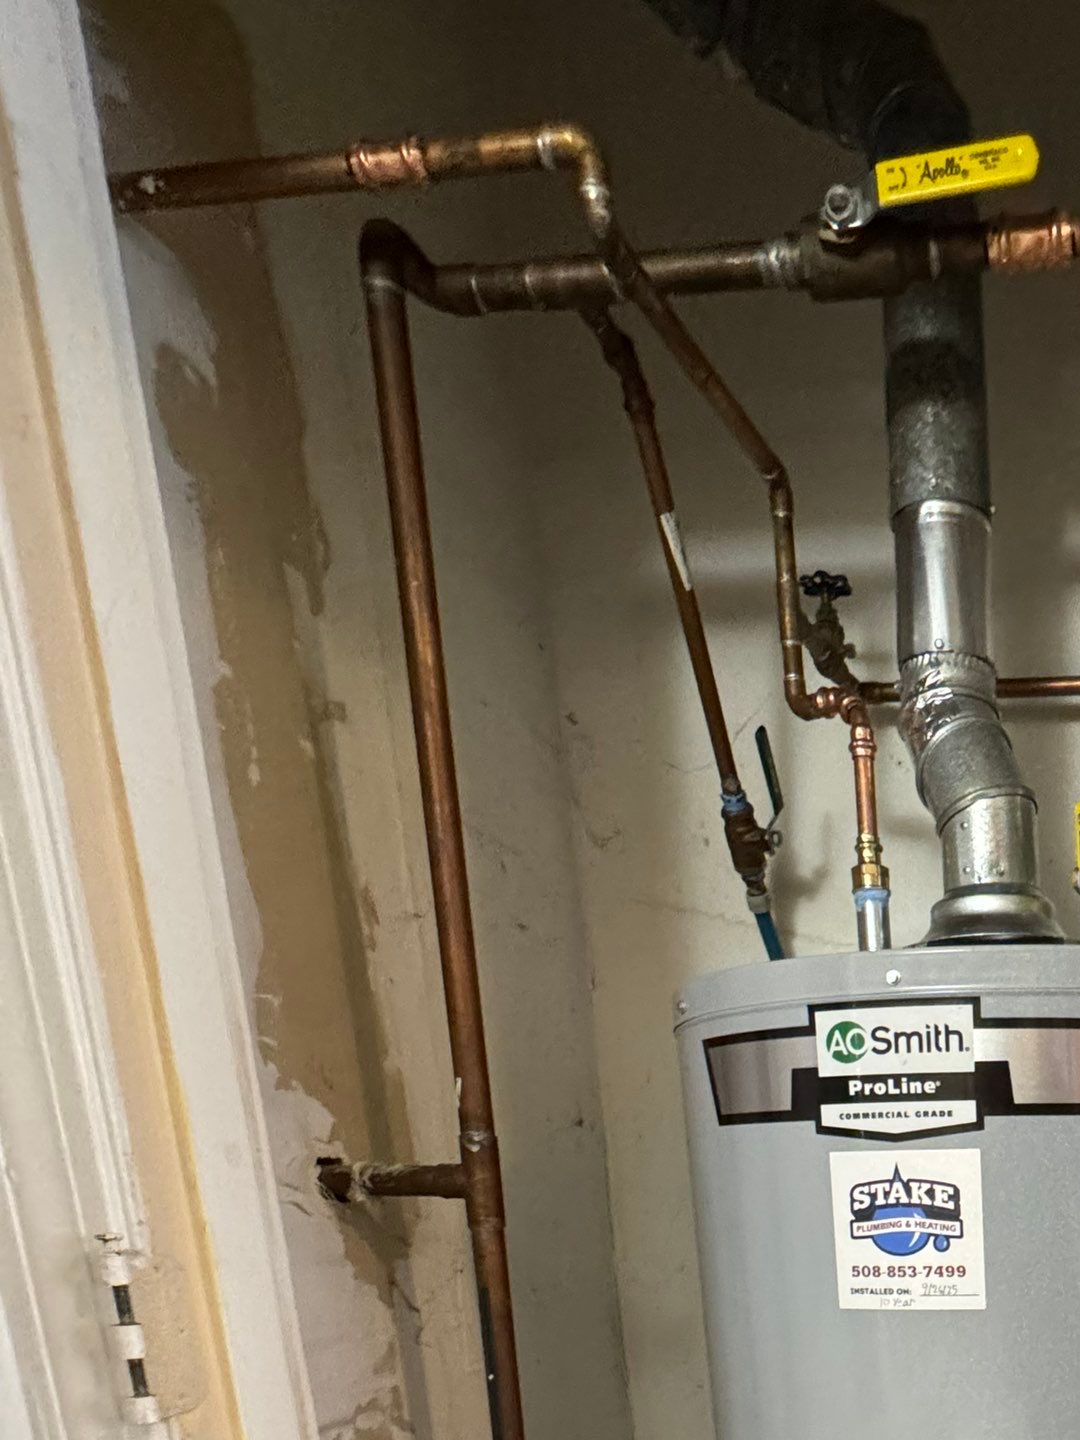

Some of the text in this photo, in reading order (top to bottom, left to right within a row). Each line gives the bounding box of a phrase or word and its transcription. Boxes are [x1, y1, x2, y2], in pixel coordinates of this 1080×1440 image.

[871, 1023, 964, 1055] Smith
[848, 1077, 936, 1096] ProLine
[839, 1110, 953, 1120] COMMERCIAL GRADE
[852, 1180, 955, 1210] STAKE
[856, 1221, 902, 1233] PLUMBING
[915, 1220, 957, 1232] HEATING
[852, 1265, 966, 1278] 508-853-7499
